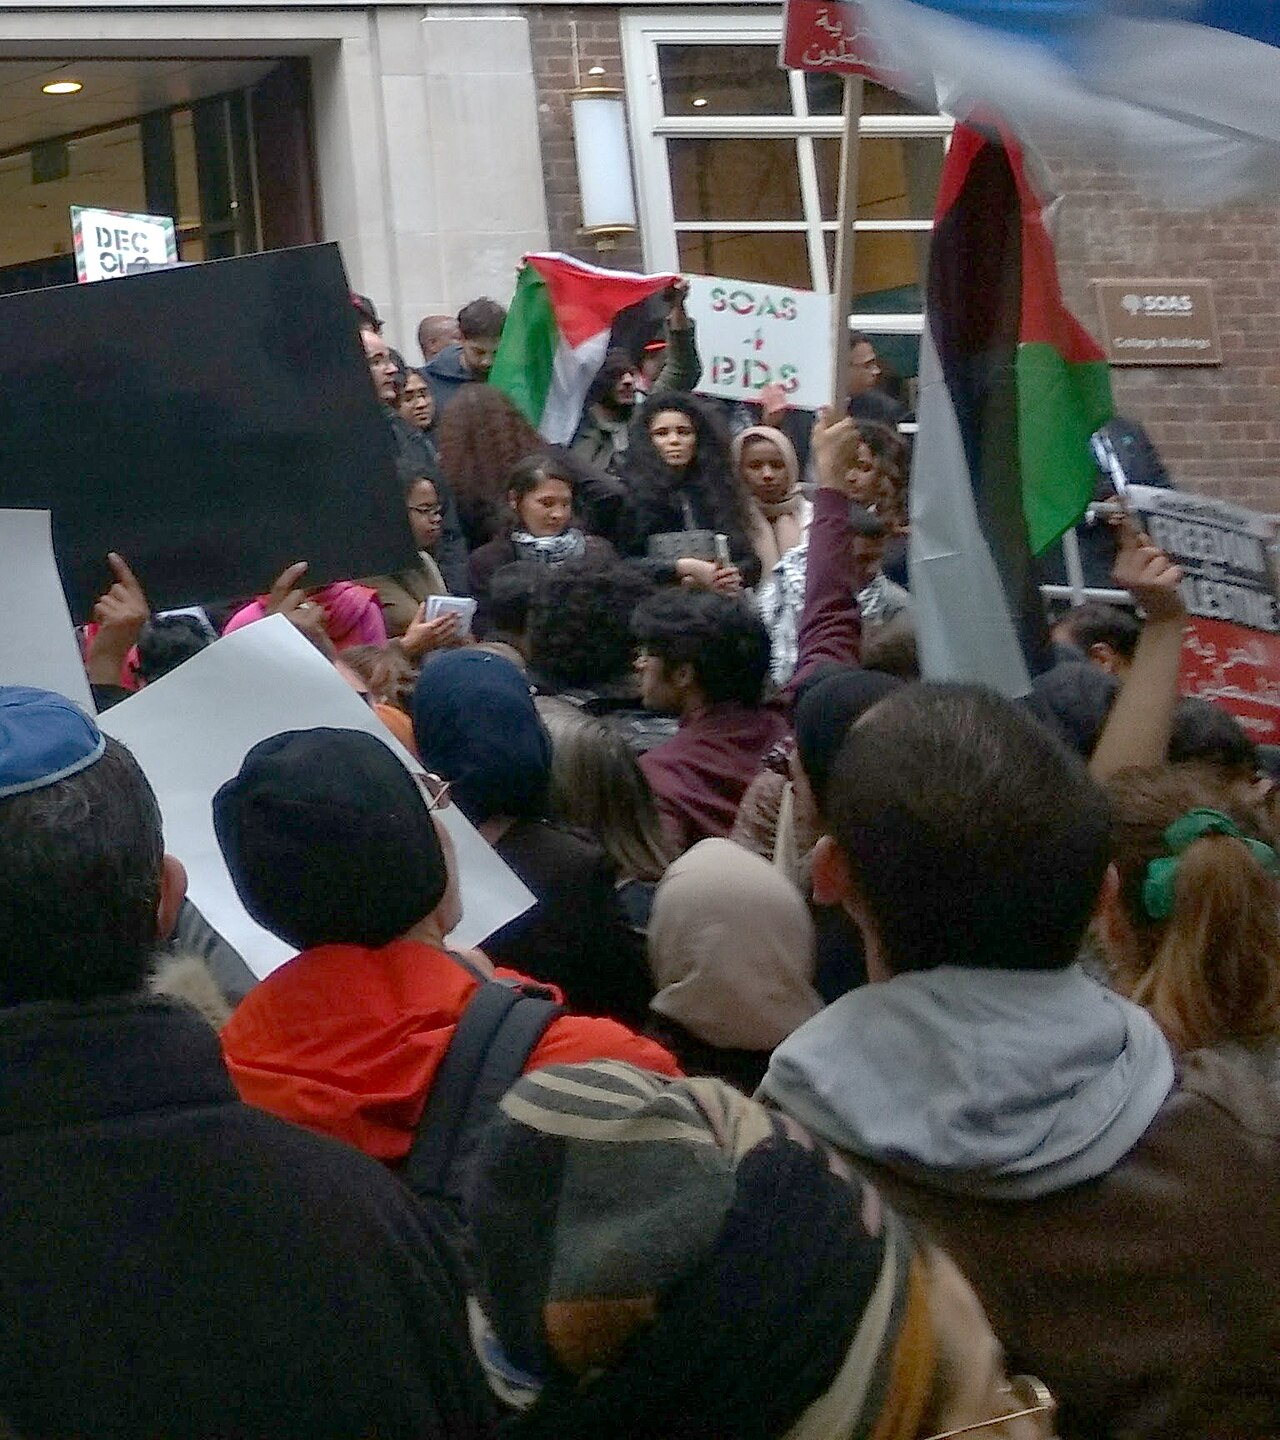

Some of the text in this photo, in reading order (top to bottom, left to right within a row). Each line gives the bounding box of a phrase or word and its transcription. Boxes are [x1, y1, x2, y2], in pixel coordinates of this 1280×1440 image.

[95, 226, 149, 253] DEC
[711, 286, 798, 322] SOAS
[1142, 294, 1193, 311] SOAS
[711, 355, 800, 395] BDS
